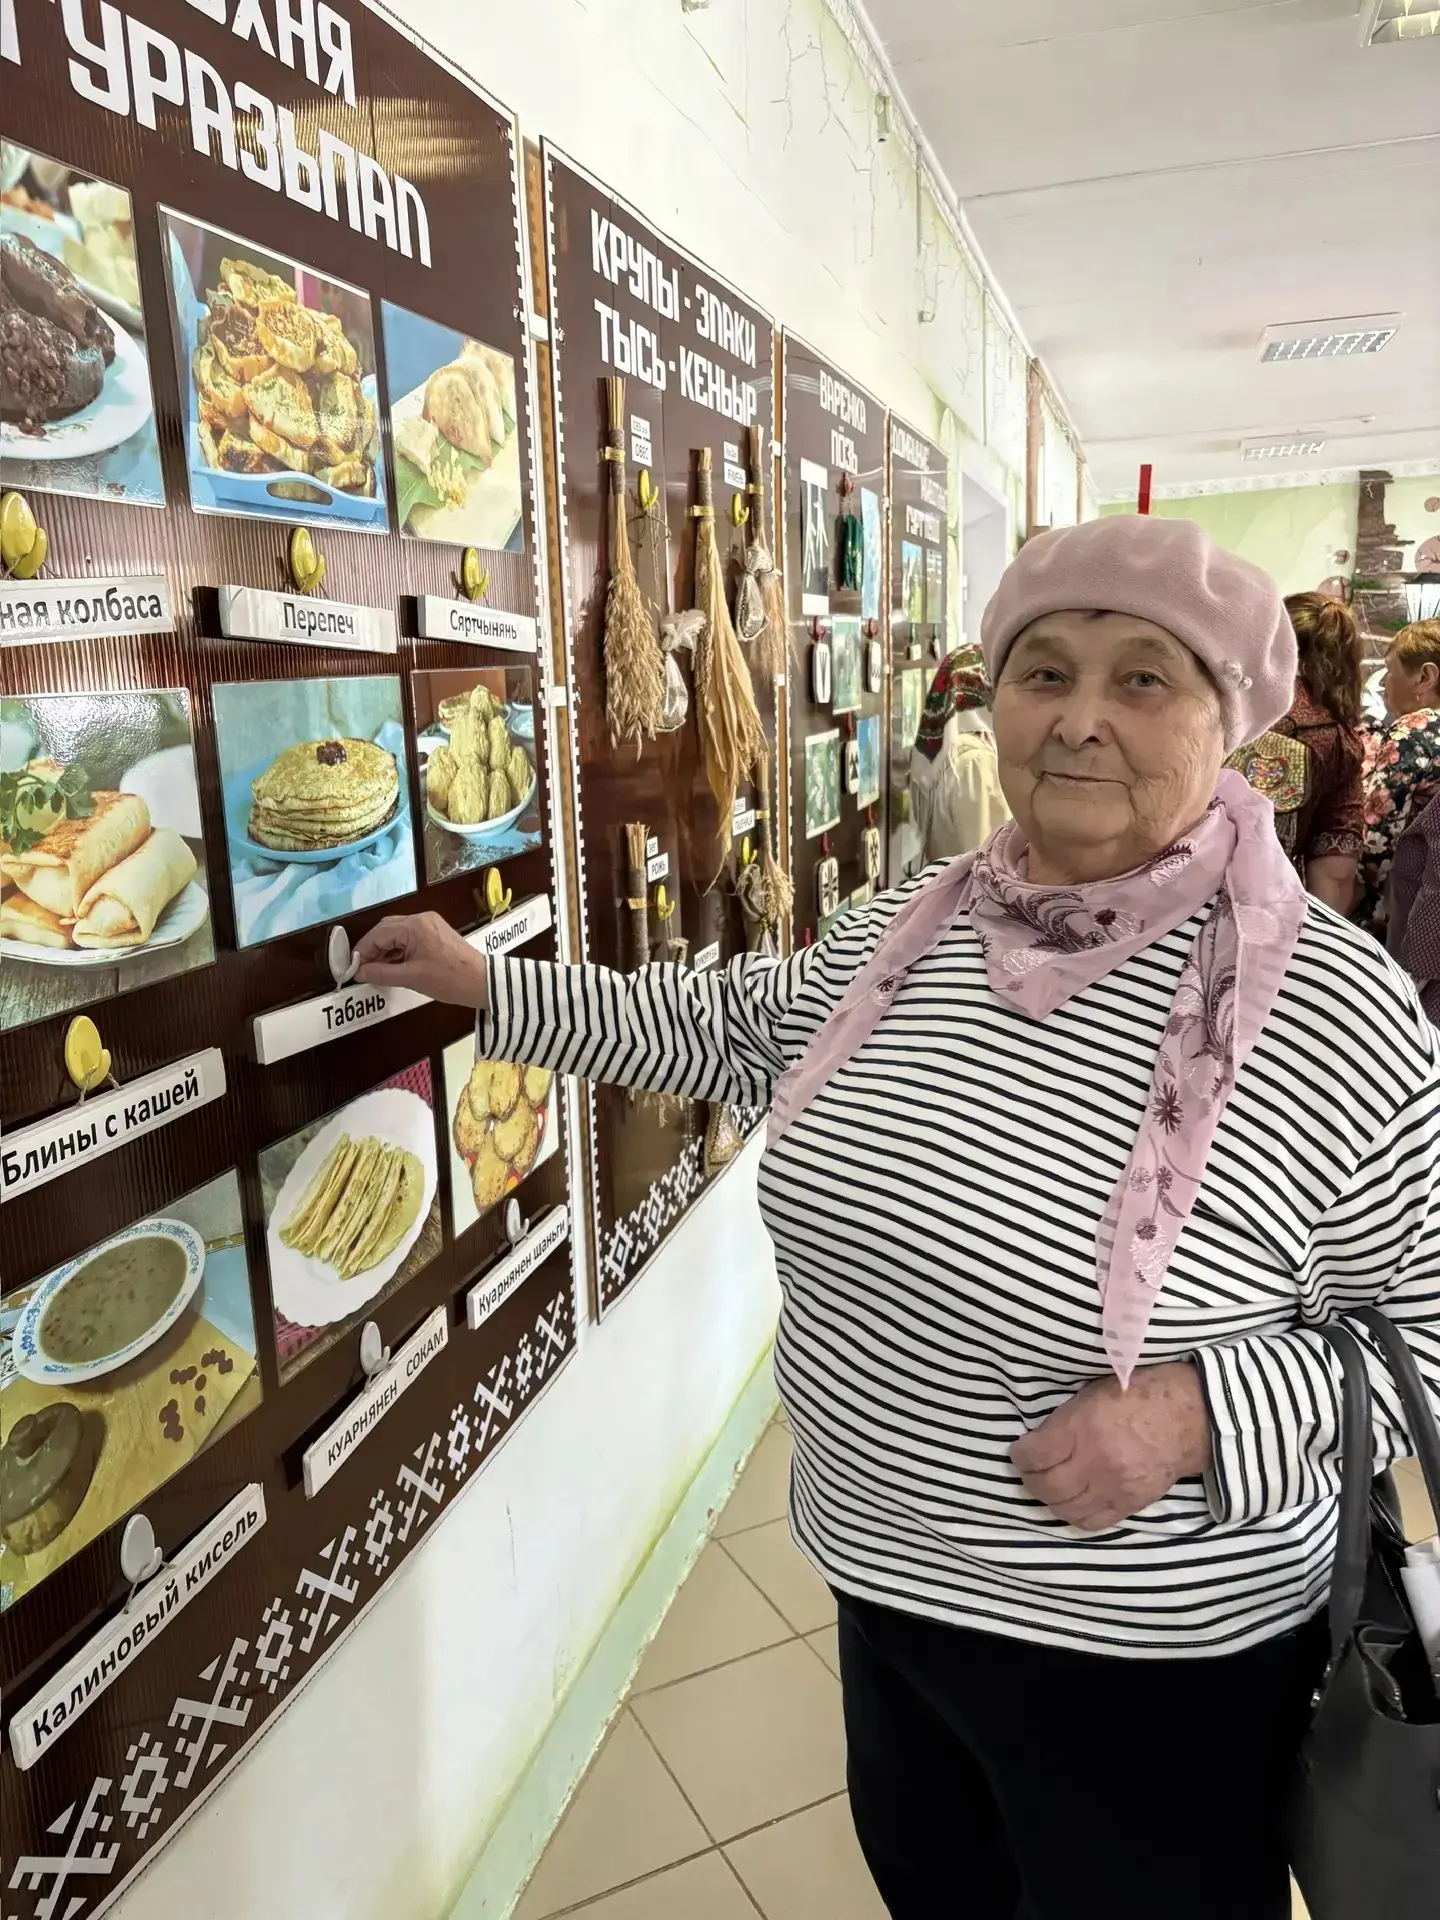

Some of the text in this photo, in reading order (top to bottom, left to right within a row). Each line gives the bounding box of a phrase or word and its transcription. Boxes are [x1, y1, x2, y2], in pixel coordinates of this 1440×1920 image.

[591, 208, 680, 323] КРУПЫ
[695, 283, 756, 369] ЗЛАКИ
[594, 298, 667, 391] ТЫСЬ
[679, 345, 757, 427] КЕНЬЫР
[57, 587, 162, 625] колбаса
[283, 601, 354, 637] Перепеч
[450, 609, 517, 640] Сяртчынянь
[485, 917, 527, 954] Кӧжыпог
[322, 994, 386, 1030] Табань
[1, 1068, 200, 1187] Блины с кашей
[479, 1219, 566, 1316] Куарнянен шаньги
[328, 1326, 444, 1466] КУАРНЯНЕН СОКАМ
[32, 1509, 258, 1748] Калиновый кисель
